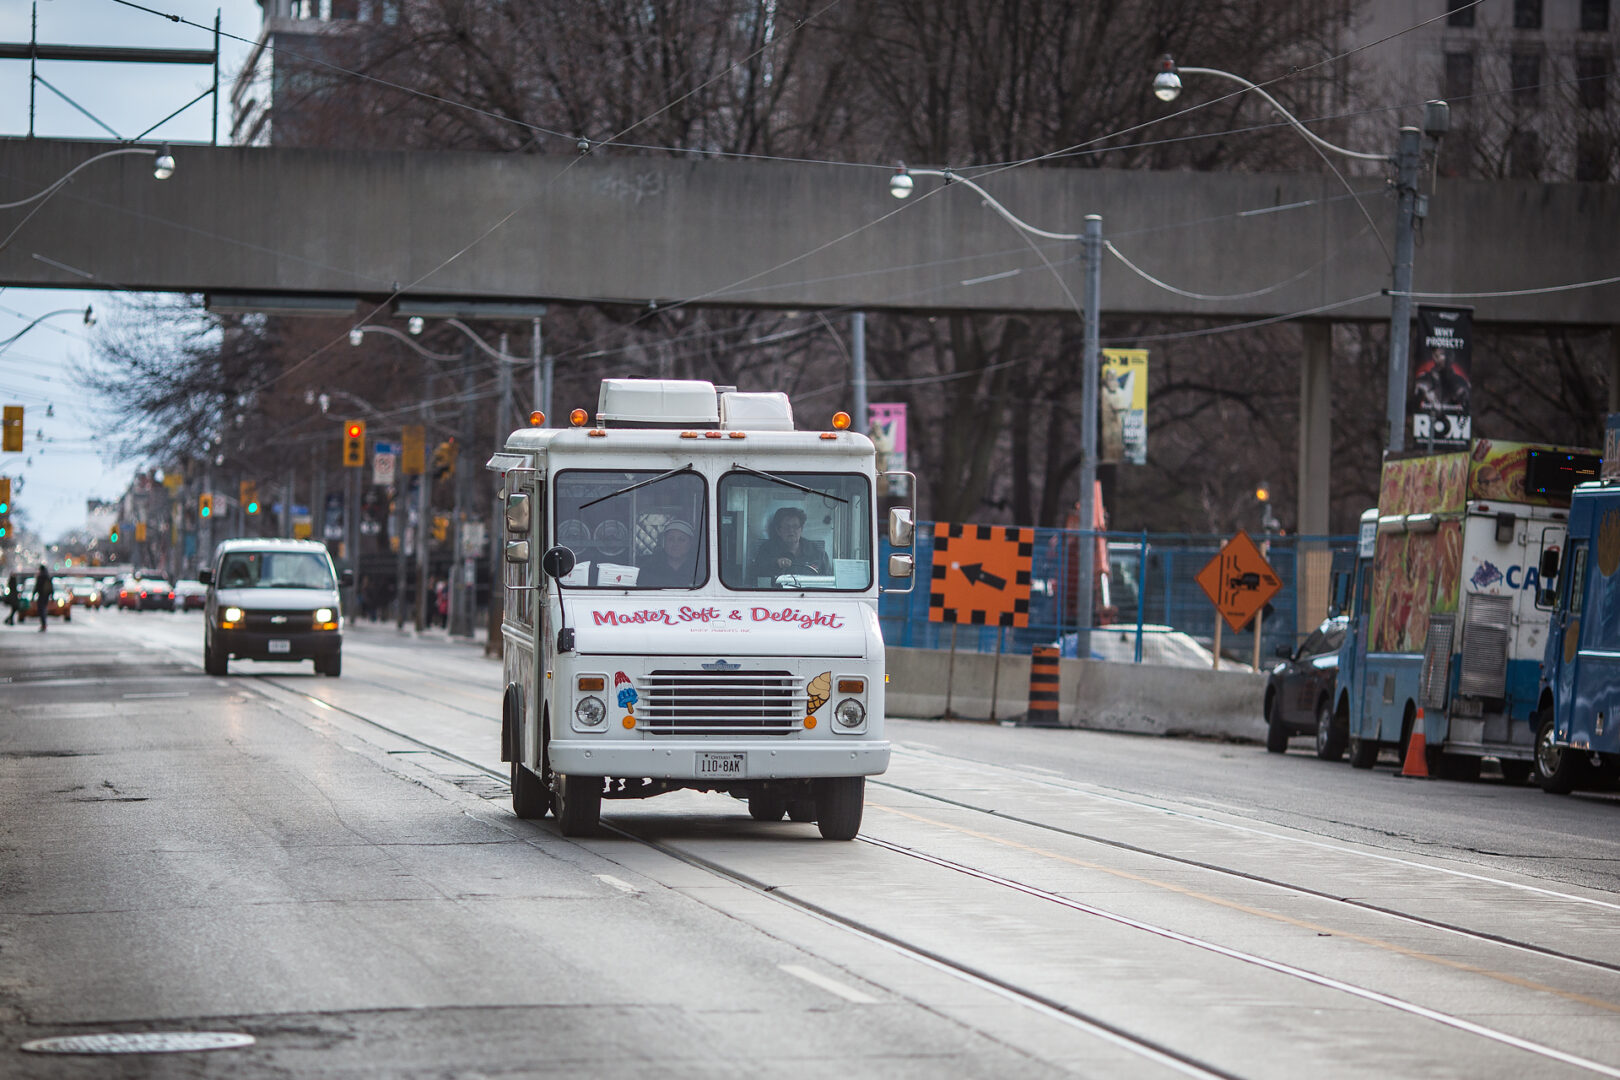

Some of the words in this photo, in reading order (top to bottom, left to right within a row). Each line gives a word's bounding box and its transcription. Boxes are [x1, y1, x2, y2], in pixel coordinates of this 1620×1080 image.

[591, 609, 679, 626] Master
[678, 606, 720, 622] Soft
[728, 609, 742, 620] &
[749, 607, 847, 629] Delight
